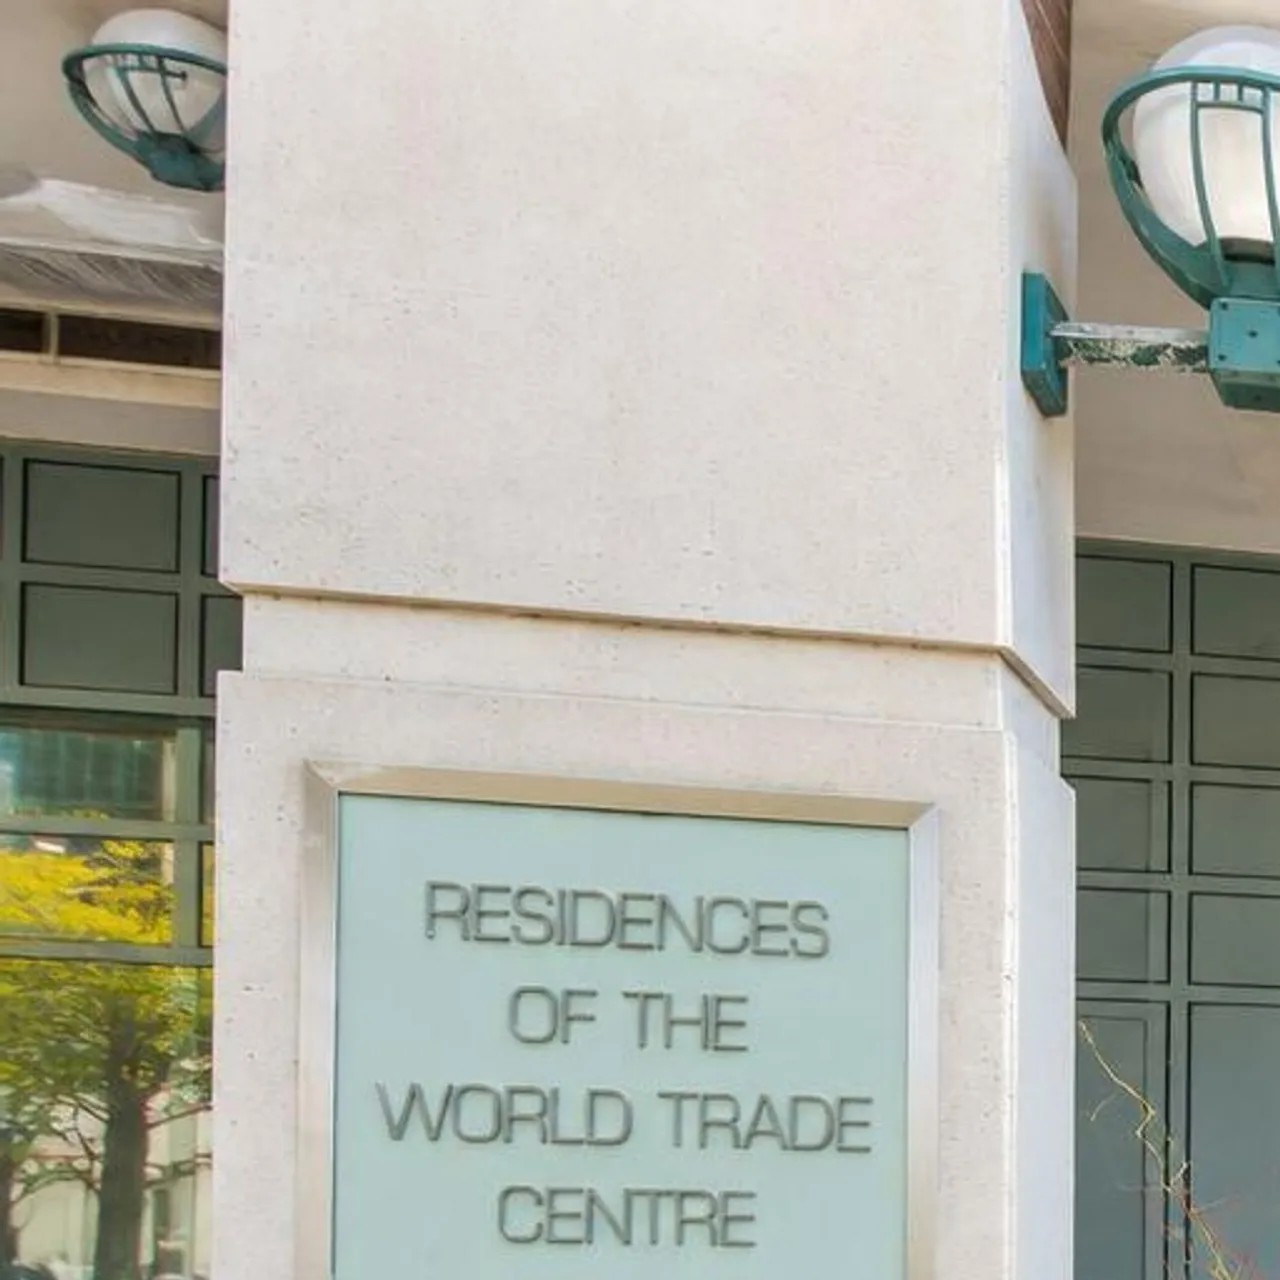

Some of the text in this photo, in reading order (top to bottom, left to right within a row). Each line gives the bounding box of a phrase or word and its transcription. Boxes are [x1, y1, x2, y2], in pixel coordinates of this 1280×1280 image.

[424, 881, 830, 958] RESIDENCES
[508, 985, 749, 1052] OF THE
[375, 1082, 874, 1154] WORLD TRADE
[498, 1185, 757, 1248] CENTRE
